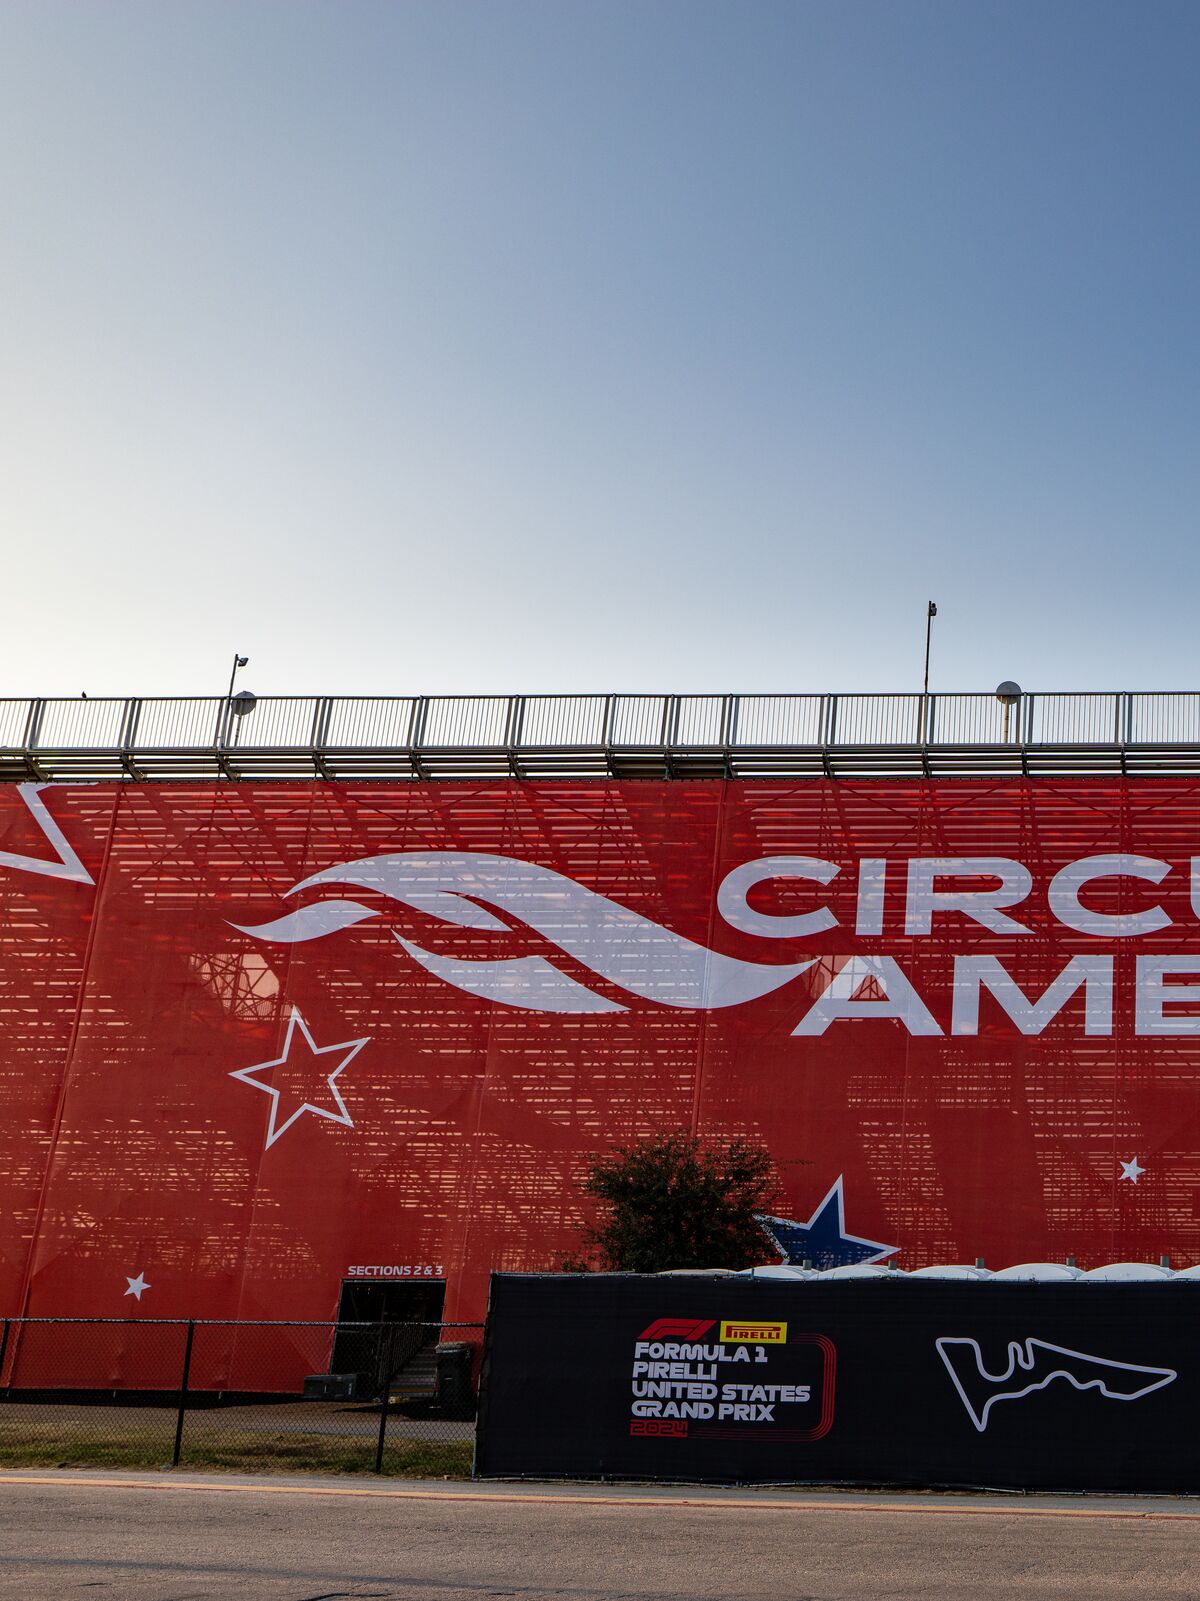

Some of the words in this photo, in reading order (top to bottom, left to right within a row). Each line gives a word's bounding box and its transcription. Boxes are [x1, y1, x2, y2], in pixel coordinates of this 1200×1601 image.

[347, 1265, 411, 1276] SECTIONS
[413, 1265, 422, 1275] 2
[423, 1265, 433, 1275] &
[434, 1265, 444, 1275] 3
[725, 1325, 782, 1340] PIRELLI
[634, 1342, 750, 1363] FORMULA
[754, 1346, 768, 1363] 1
[632, 1361, 718, 1381] PIRELLI
[631, 1380, 718, 1401] UNITED
[721, 1384, 811, 1402] STATES
[631, 1400, 715, 1420] GRAND
[718, 1403, 775, 1422] PRIX
[630, 1419, 689, 1437] 2024
